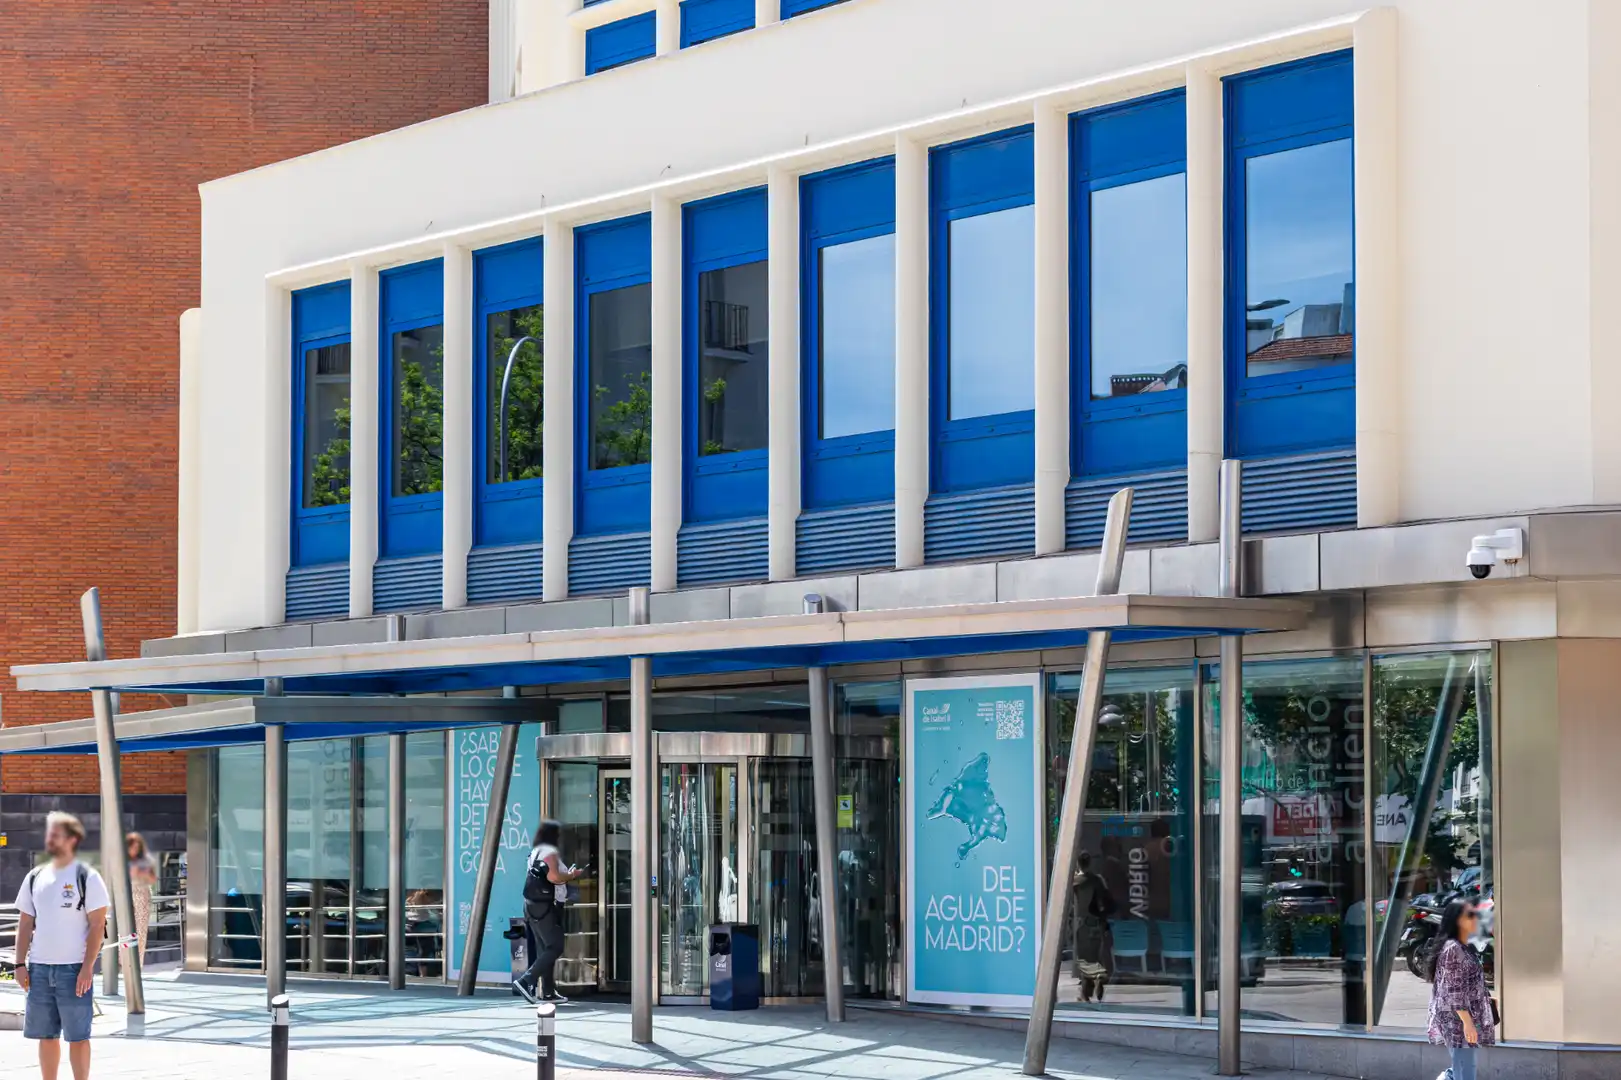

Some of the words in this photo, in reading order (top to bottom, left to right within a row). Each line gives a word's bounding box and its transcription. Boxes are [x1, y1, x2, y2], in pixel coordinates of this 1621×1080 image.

[460, 732, 518, 755] ¿SAB
[461, 755, 482, 778] LO
[486, 754, 522, 777] QE
[461, 780, 491, 801] HAY
[461, 803, 522, 826] DETAS
[461, 827, 481, 849] DE
[983, 865, 1025, 893] DEL
[924, 894, 989, 922] AGUA
[996, 896, 1026, 923] DE
[925, 925, 1026, 953] MADRID?
